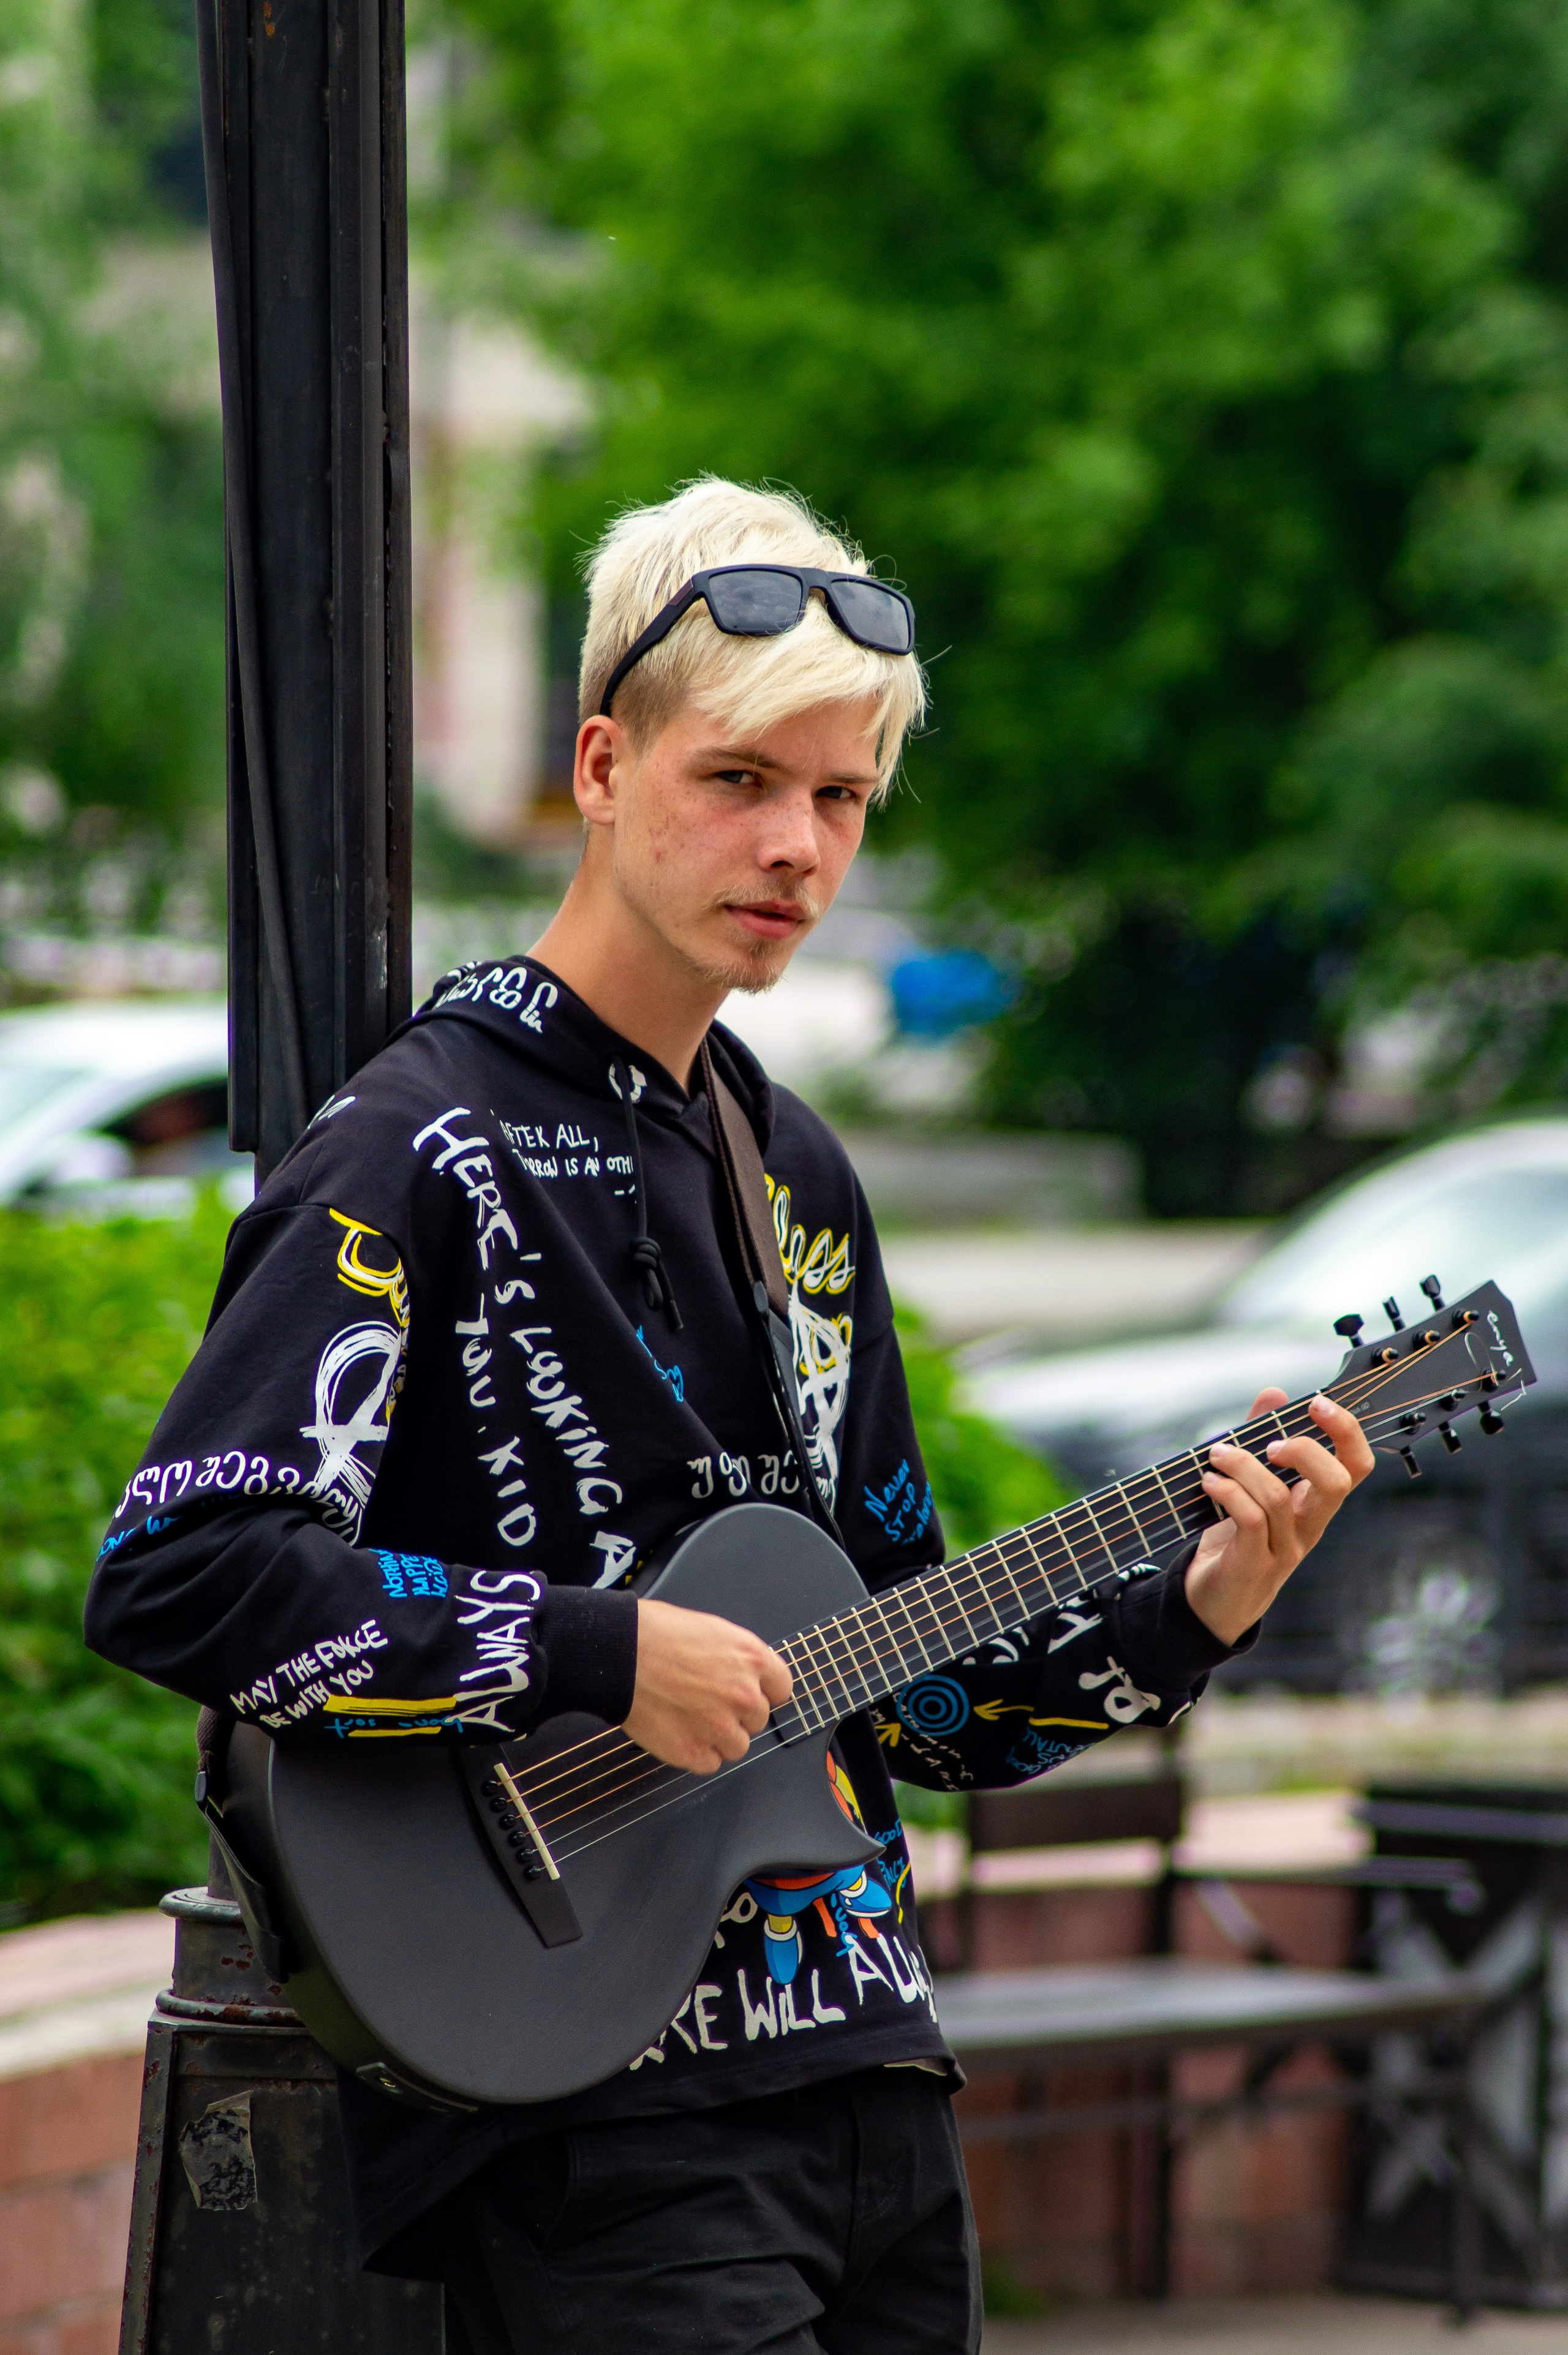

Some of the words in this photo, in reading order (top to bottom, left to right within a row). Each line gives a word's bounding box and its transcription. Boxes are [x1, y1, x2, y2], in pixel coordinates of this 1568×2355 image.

[565, 1158, 578, 1177] IS
[584, 1156, 600, 1177] AN
[606, 1155, 633, 1175] OTH
[477, 1436, 537, 1547] KID
[230, 1675, 279, 1714] MAY
[276, 1652, 322, 1687] THE
[445, 1569, 541, 1733] ALWAYS
[284, 1680, 332, 1719] WITH
[328, 1659, 375, 1695] YOU
[737, 1969, 846, 2041] WILL
